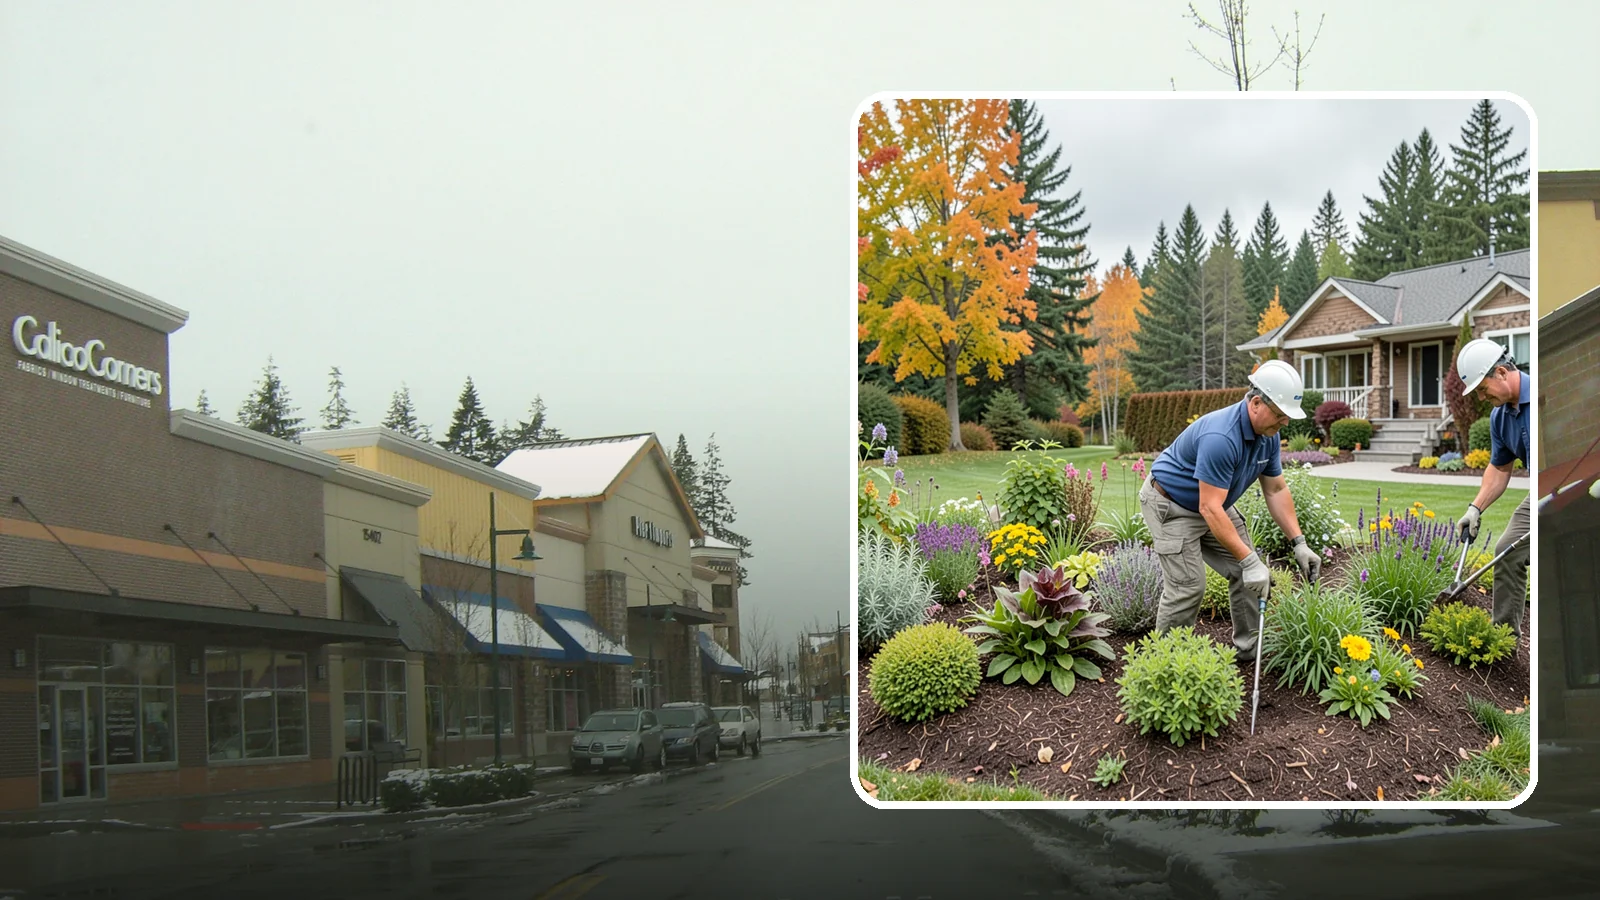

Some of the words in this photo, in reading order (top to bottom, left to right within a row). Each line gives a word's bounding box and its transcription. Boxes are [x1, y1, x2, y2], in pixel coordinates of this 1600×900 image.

[17, 360, 47, 378] FABRICS
[51, 370, 78, 387] WINDOW
[78, 378, 117, 398] TREATMENTS
[119, 391, 151, 409] FURNITURE
